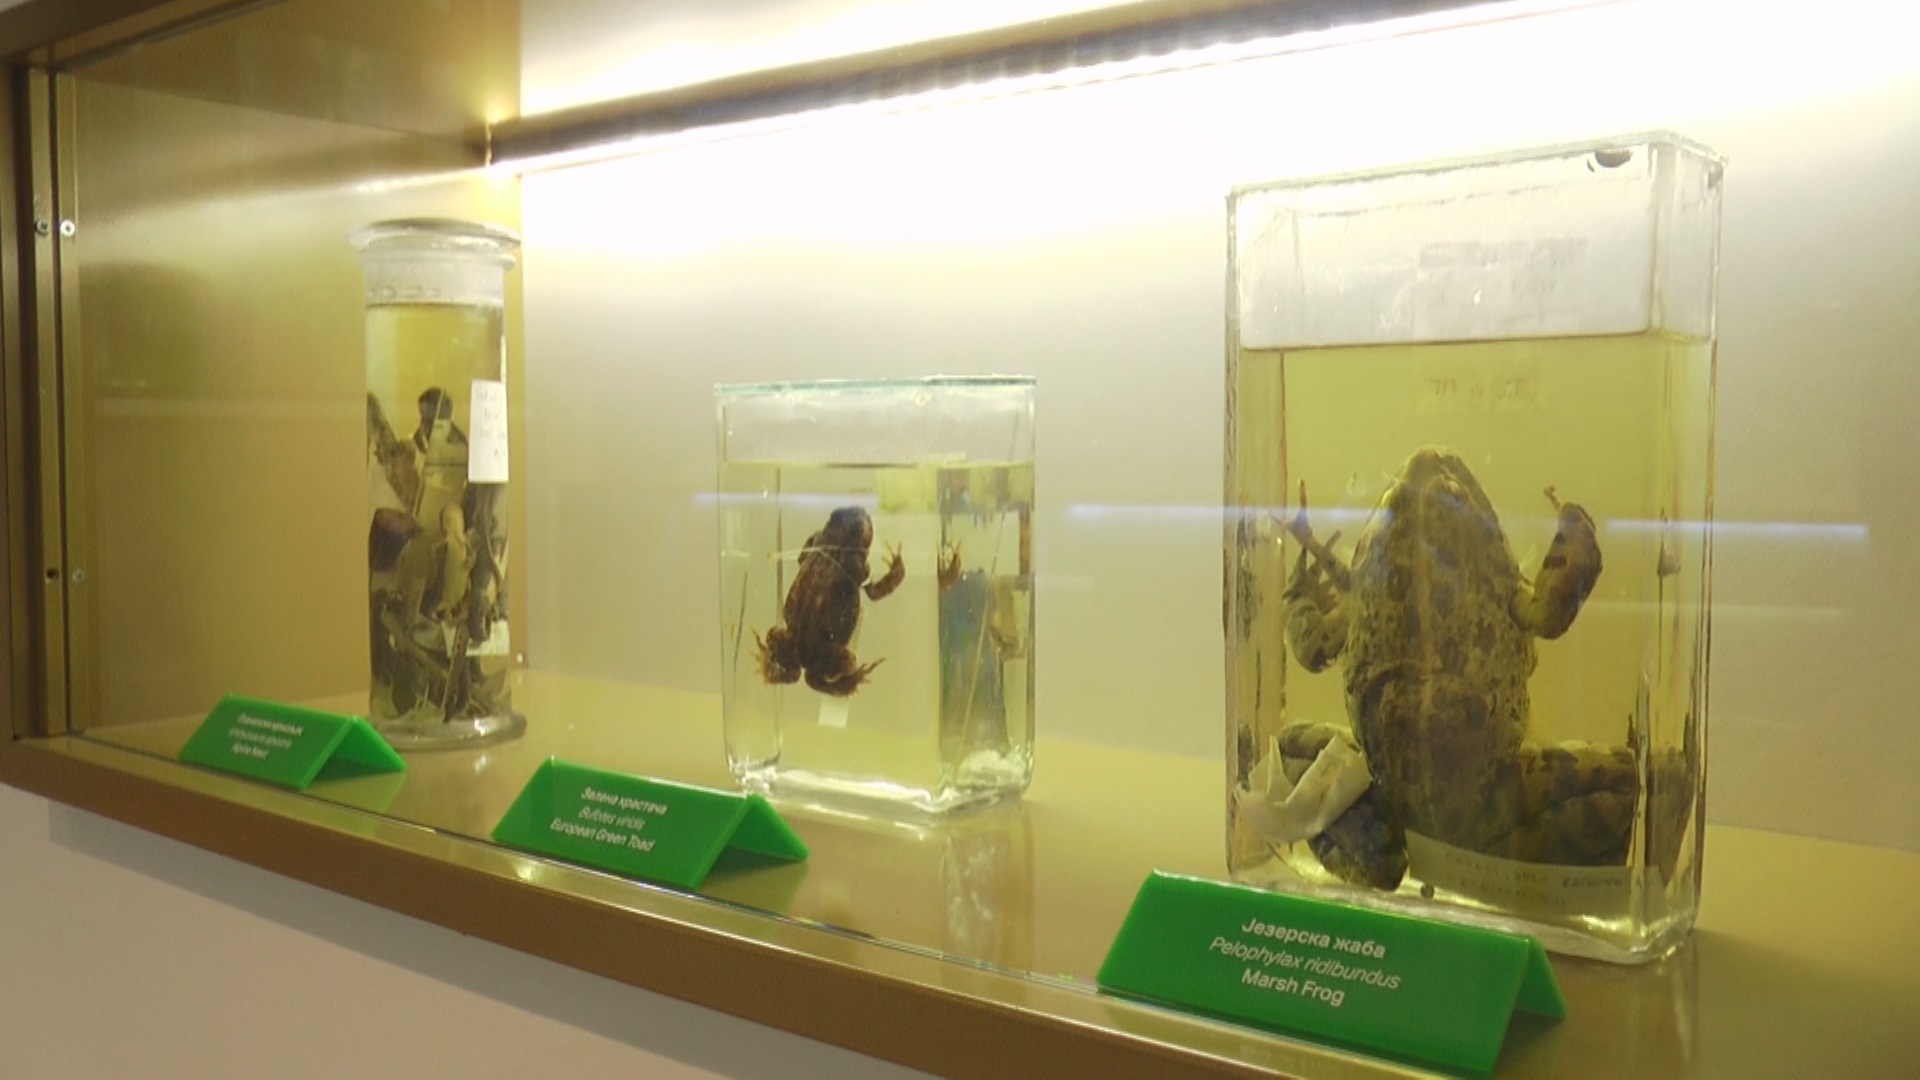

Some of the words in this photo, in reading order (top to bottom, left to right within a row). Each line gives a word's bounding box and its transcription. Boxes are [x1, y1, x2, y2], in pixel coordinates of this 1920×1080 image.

[550, 817, 596, 838] European
[596, 829, 627, 845] Green
[627, 834, 656, 852] Toad
[1241, 917, 1331, 948] Језерска
[1332, 937, 1386, 959] жаба
[1209, 936, 1304, 969] Pelophylax
[1303, 957, 1401, 989] ridibundus
[1241, 967, 1299, 994] Marsh
[1301, 980, 1346, 1007] Frog
